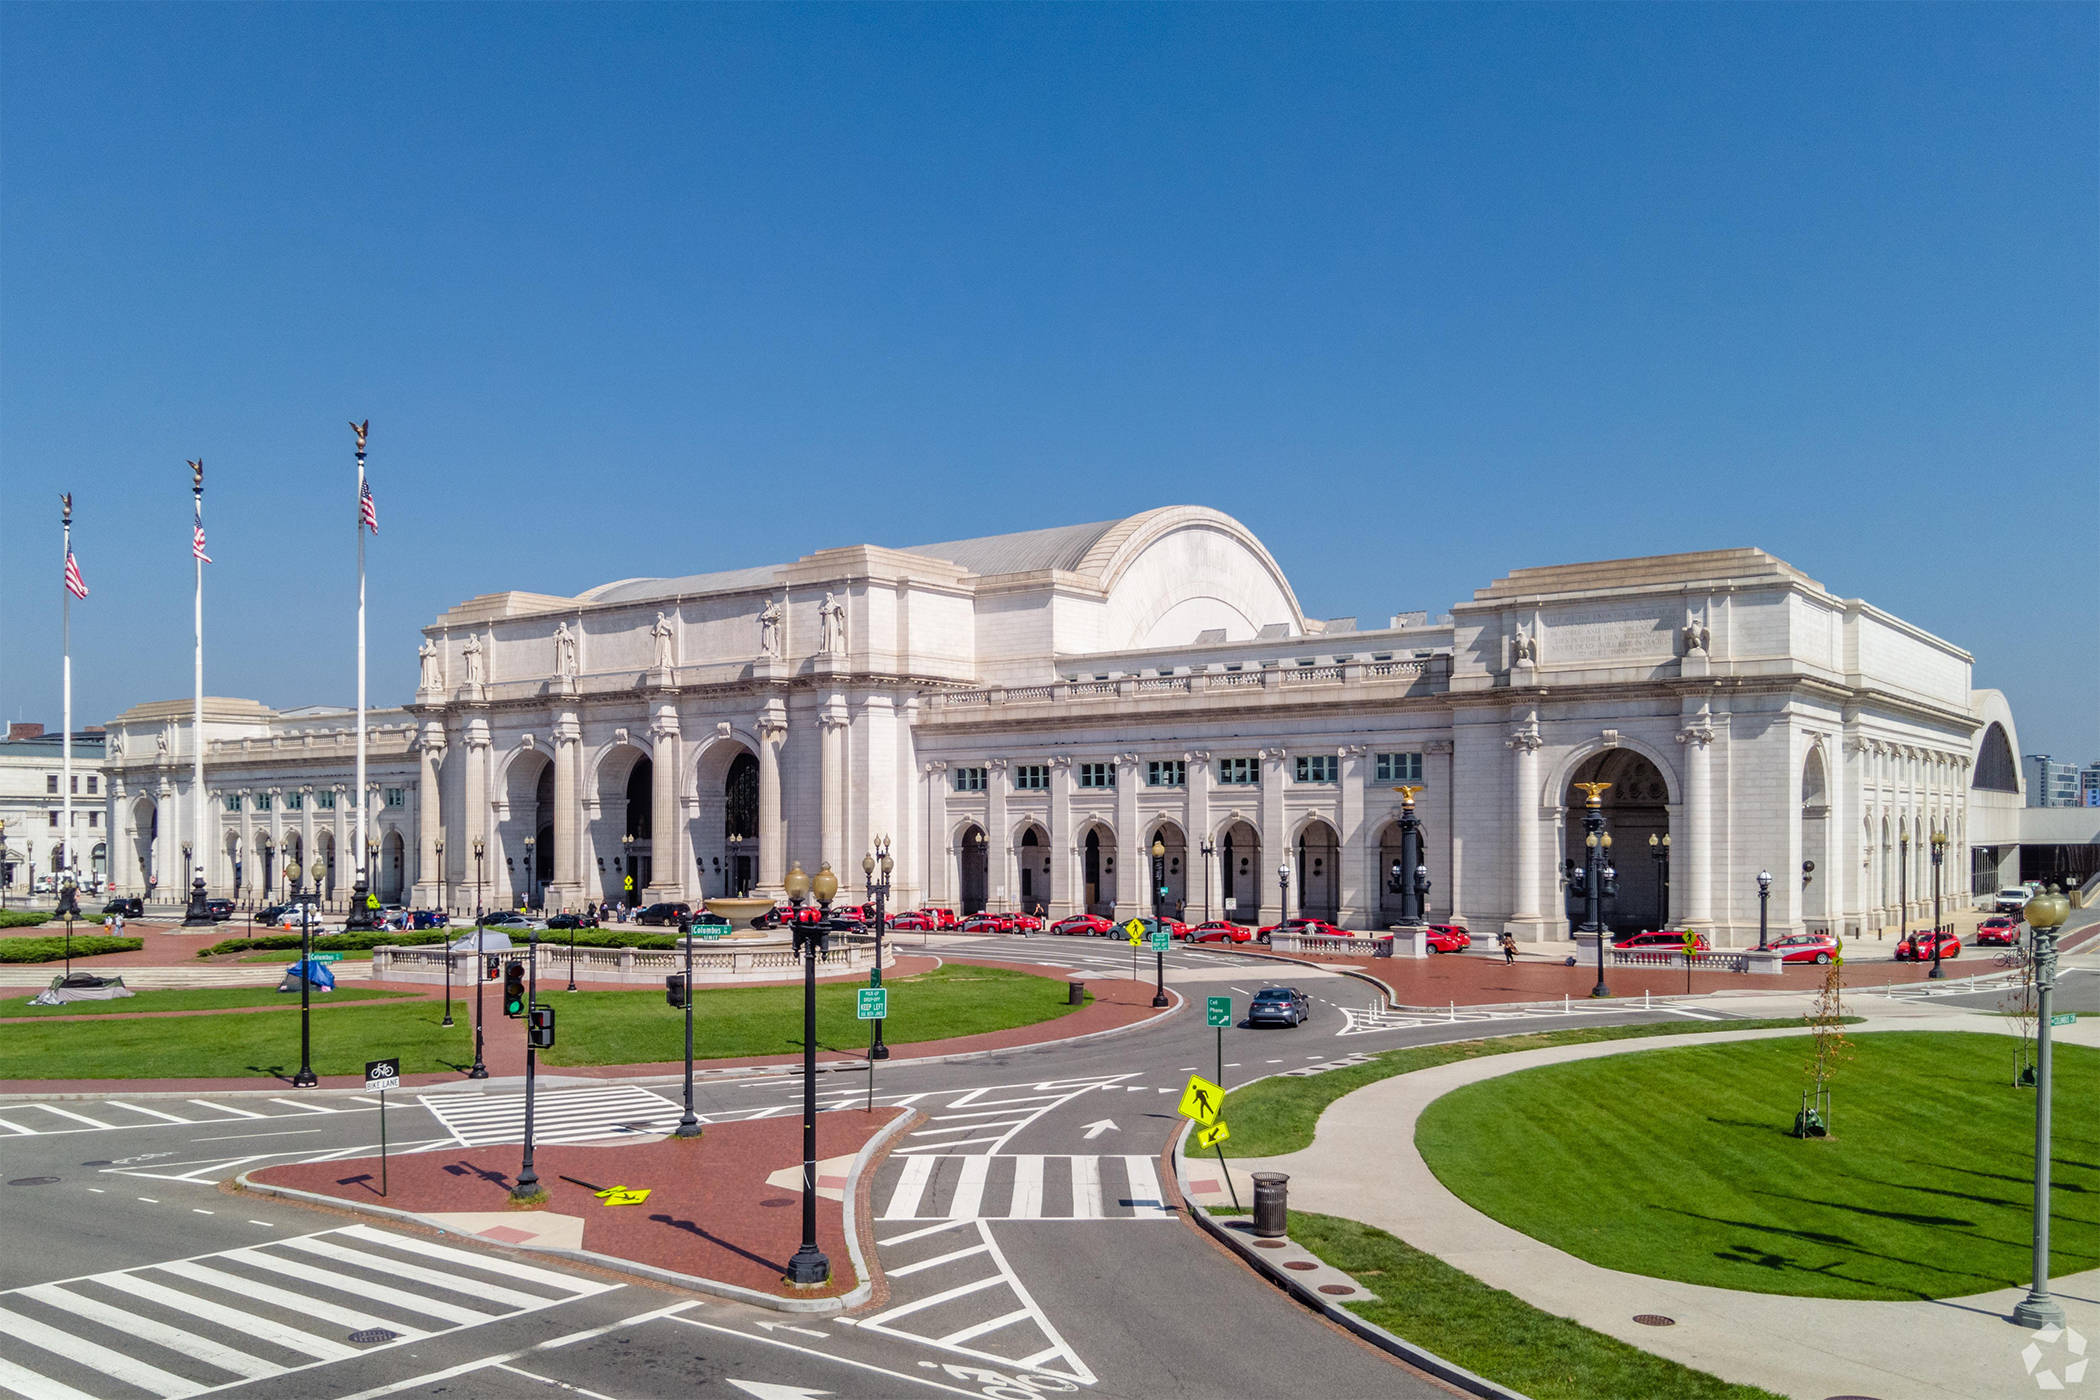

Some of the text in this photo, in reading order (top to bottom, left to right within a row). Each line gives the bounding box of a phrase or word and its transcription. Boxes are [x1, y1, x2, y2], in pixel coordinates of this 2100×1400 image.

[694, 926, 721, 935] Columbus
[366, 1078, 399, 1092] BIKE LANE
